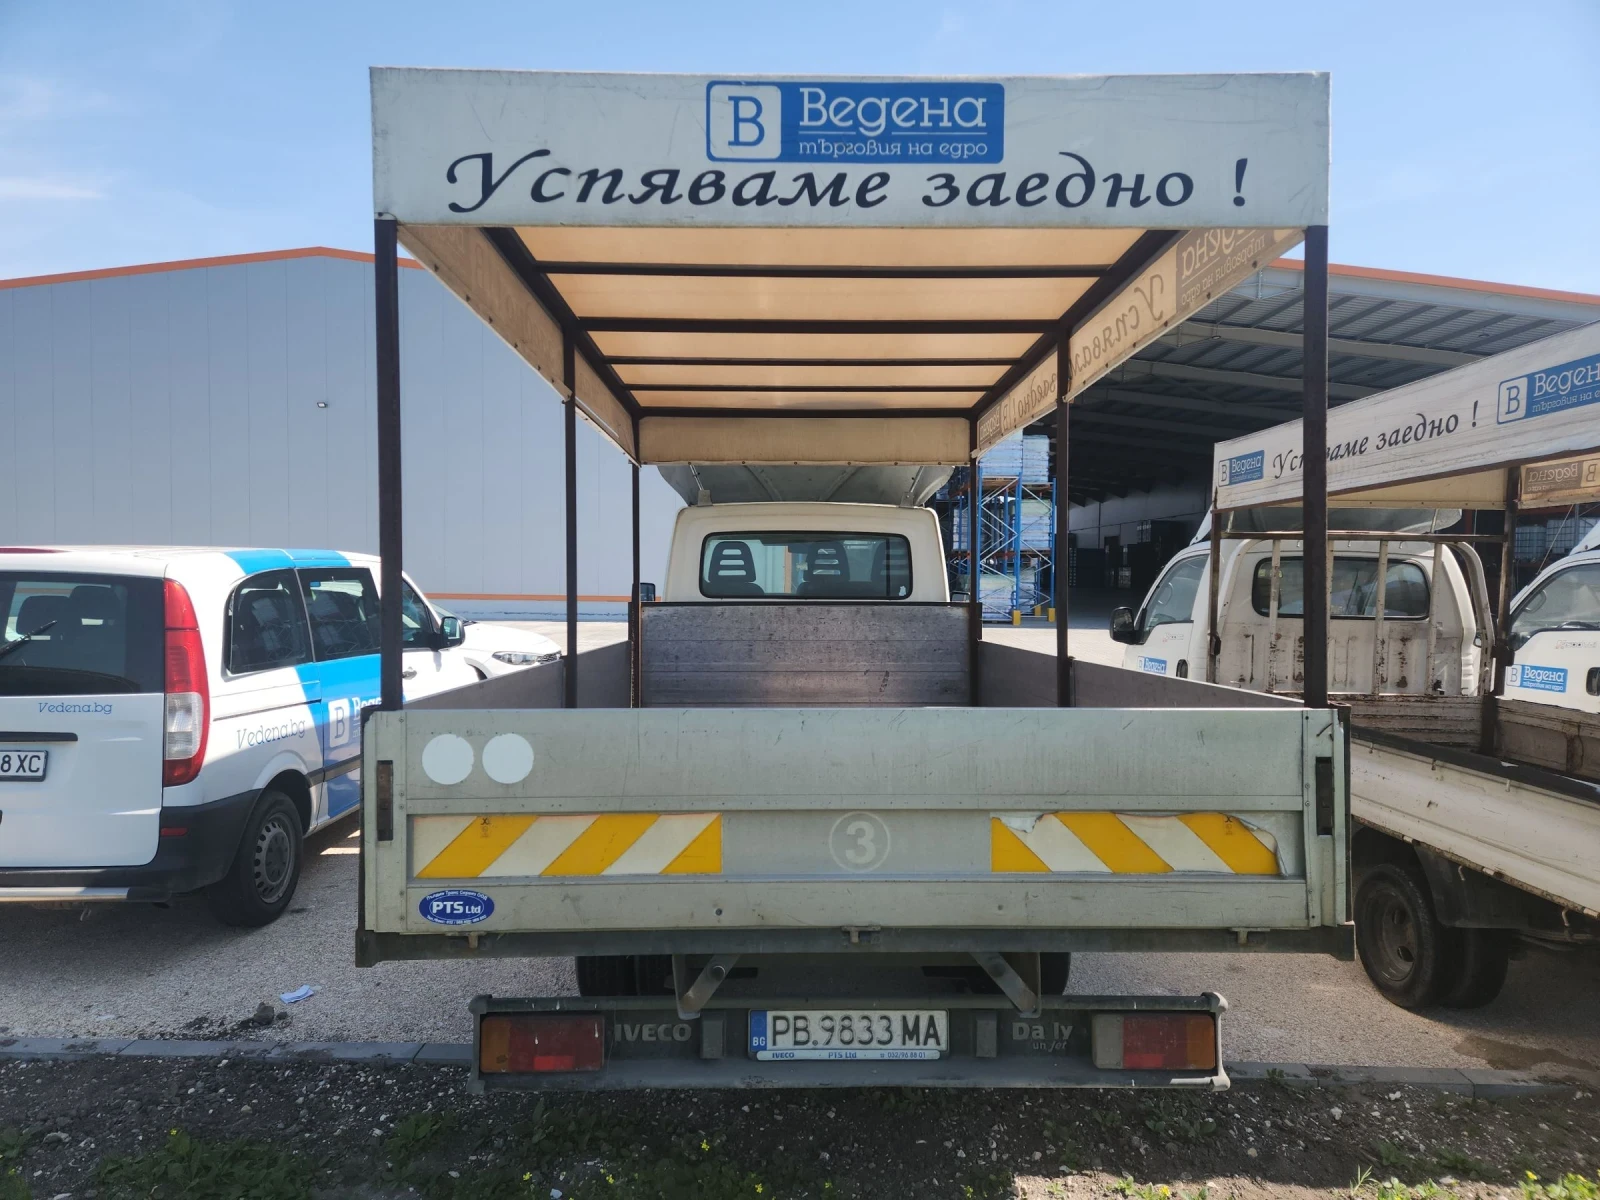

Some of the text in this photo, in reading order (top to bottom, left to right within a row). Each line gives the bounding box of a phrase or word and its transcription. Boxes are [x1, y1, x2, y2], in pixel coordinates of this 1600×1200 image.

[799, 87, 988, 137] Ведена
[799, 138, 988, 159] търговия на едро
[446, 148, 891, 214] Успяваме
[921, 151, 1195, 209] заедно
[1375, 412, 1459, 452] заедно
[1524, 666, 1565, 683] Ведена
[38, 701, 113, 716] Vedena.bg
[236, 718, 306, 750] Vedena.bg
[845, 820, 876, 865] 3
[432, 901, 481, 914] PTS Ltd
[614, 1023, 692, 1041] IVECO
[752, 1036, 766, 1046] BG
[1012, 1022, 1073, 1041] Daly
